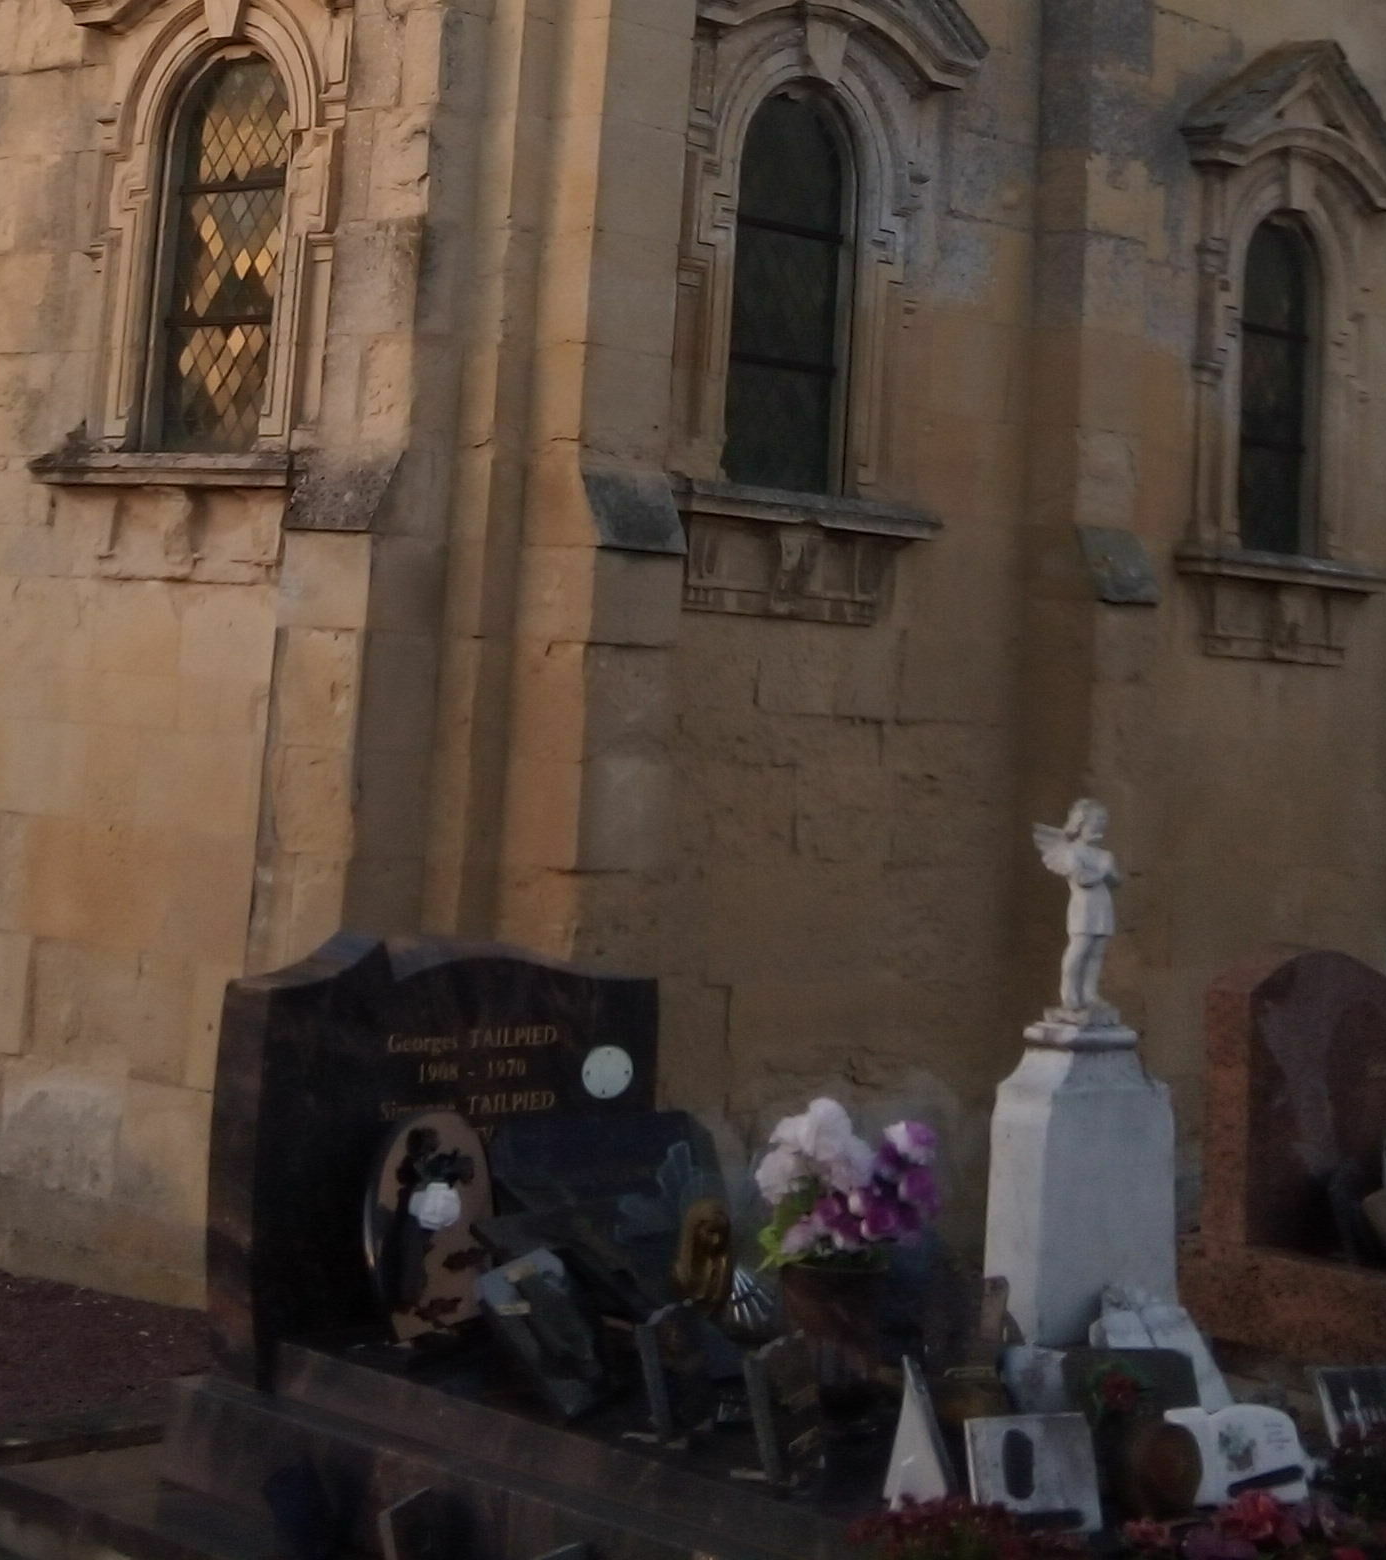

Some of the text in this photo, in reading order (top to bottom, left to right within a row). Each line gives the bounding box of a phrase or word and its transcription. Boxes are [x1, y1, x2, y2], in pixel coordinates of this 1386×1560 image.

[387, 1024, 559, 1056] Georges TAILPIED
[487, 1057, 528, 1078] 1970
[467, 1090, 557, 1116] TAILPIED
